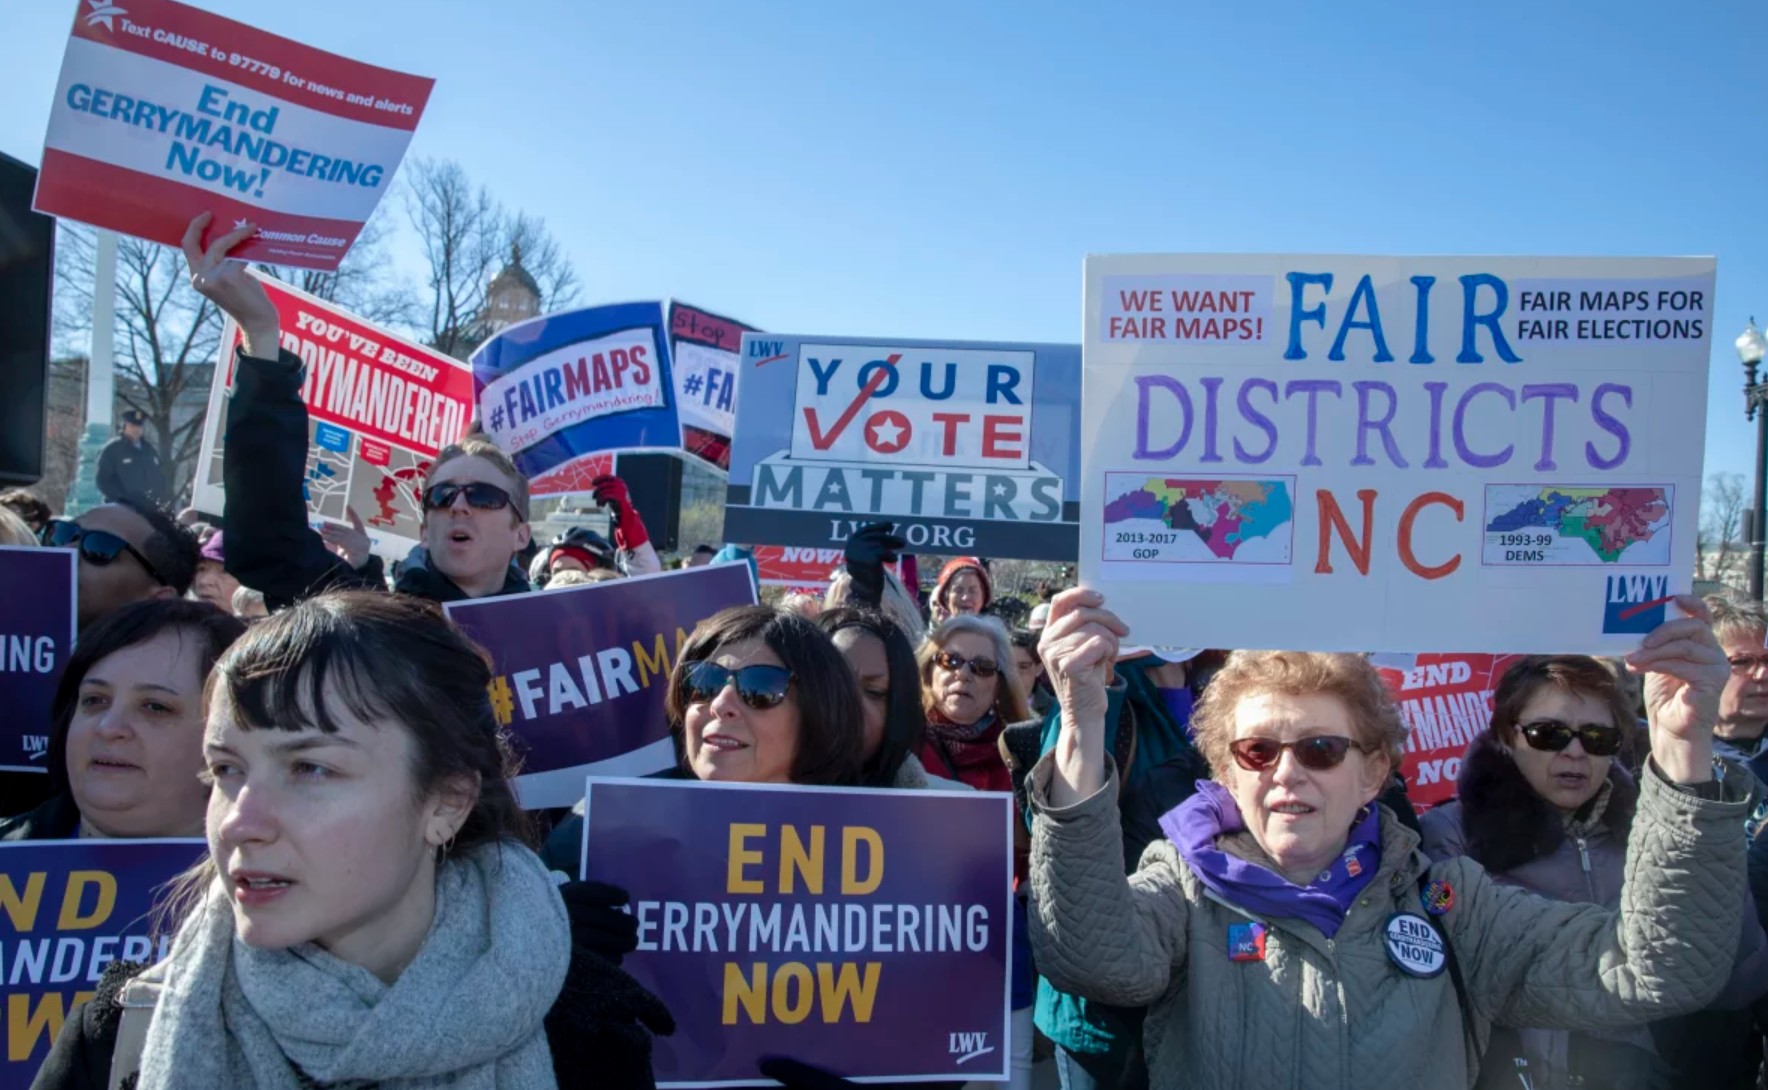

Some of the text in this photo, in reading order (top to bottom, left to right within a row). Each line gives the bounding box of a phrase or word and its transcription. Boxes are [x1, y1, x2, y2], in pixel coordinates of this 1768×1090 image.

[121, 18, 414, 115] Text CAUSE to 97779 for news and alerts
[197, 84, 279, 135] End
[66, 83, 384, 188] GERRYMANDERING
[165, 141, 271, 198] Now!
[307, 233, 347, 247] Cause
[1120, 290, 1256, 313] WE WANT
[1283, 271, 1525, 364] FAIR
[1519, 290, 1704, 312] FAIR MAPS FOR
[296, 310, 440, 383] YOU'VE BEEN
[674, 311, 725, 347] Stop
[1109, 316, 1263, 341] FAIR MAPS!
[1518, 319, 1704, 340] FAIR ELECTIONS
[749, 341, 784, 358] LWV
[490, 345, 651, 433] #FAIRMAPS
[683, 367, 736, 414] #FA
[807, 358, 1024, 405] YOUR
[511, 427, 538, 450] Stop
[803, 405, 1024, 460] VOTE
[1132, 374, 1634, 472] DISTRICTS
[754, 463, 1061, 522] MATTERS
[1115, 532, 1178, 544] 2013-2017
[1314, 488, 1464, 579] NC
[1499, 534, 1553, 546] 1993-99
[1132, 548, 1160, 560] GOP
[1505, 550, 1545, 561] DEMS
[1608, 575, 1669, 602] LWV
[1402, 661, 1471, 691] END
[726, 822, 885, 896] END
[612, 901, 989, 953] ERRYMANDERING
[1398, 919, 1431, 939] END
[1400, 943, 1434, 965] NOW
[721, 961, 882, 1025] NOW
[948, 1031, 988, 1053] LWV
